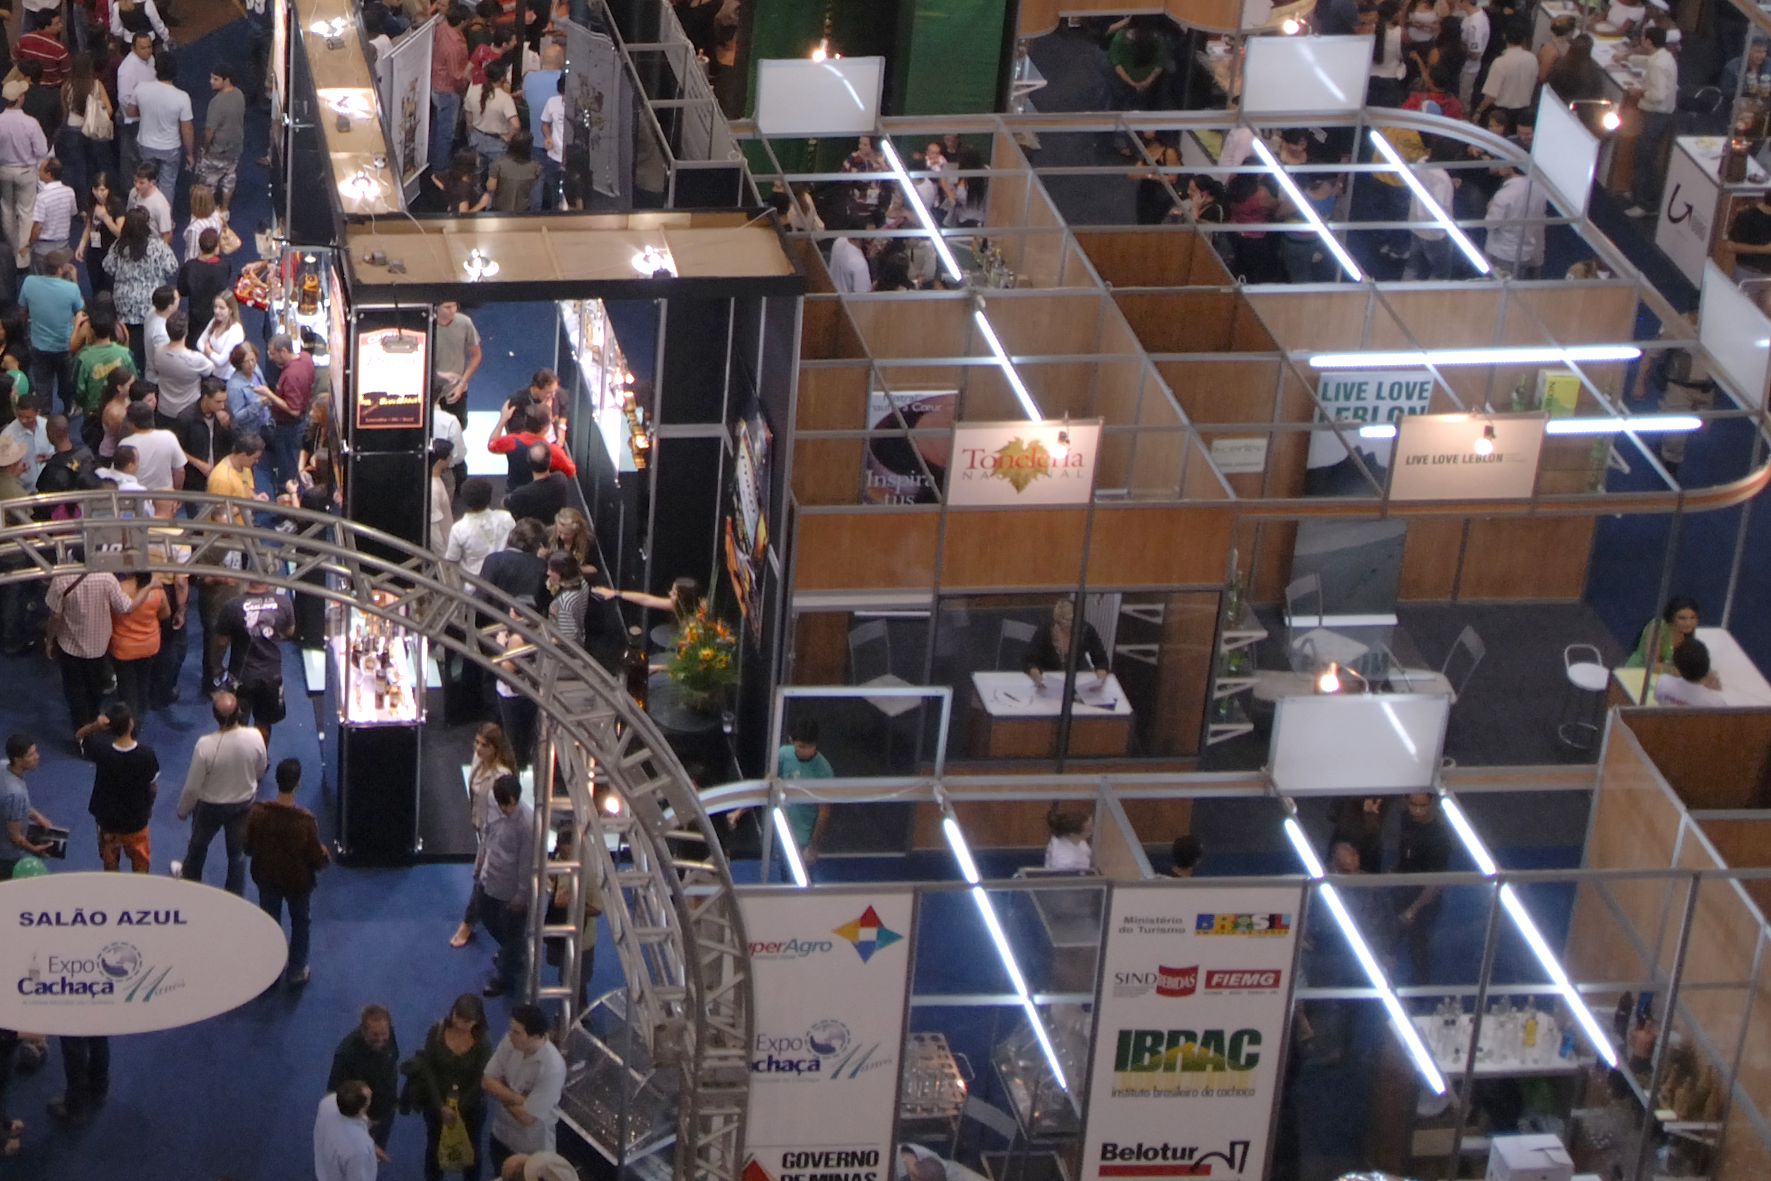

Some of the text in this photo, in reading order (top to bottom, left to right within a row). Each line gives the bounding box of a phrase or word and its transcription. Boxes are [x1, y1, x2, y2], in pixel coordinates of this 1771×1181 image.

[1321, 380, 1431, 402] LIVE LOVE
[1406, 454, 1503, 465] LIVE LOVE LEBLON
[962, 470, 1085, 480] NACNAL
[884, 495, 916, 506] tus
[19, 907, 187, 928] SALÃO AZUL
[1124, 916, 1183, 924] Ministério
[1119, 926, 1134, 934] do
[1138, 925, 1186, 934] Turismo
[749, 939, 833, 957] perAgro
[49, 956, 95, 979] Expo
[17, 976, 114, 999] Cachaça
[1211, 972, 1275, 987] FIEMG
[756, 1034, 803, 1056] Expo
[1114, 1028, 1263, 1073] IBRAC
[749, 1054, 820, 1077] chaça
[1111, 1086, 1153, 1098] instituto
[1153, 1085, 1198, 1098] brasileiro
[782, 1150, 880, 1170] GOVERNO
[1100, 1142, 1198, 1162] Belotur
